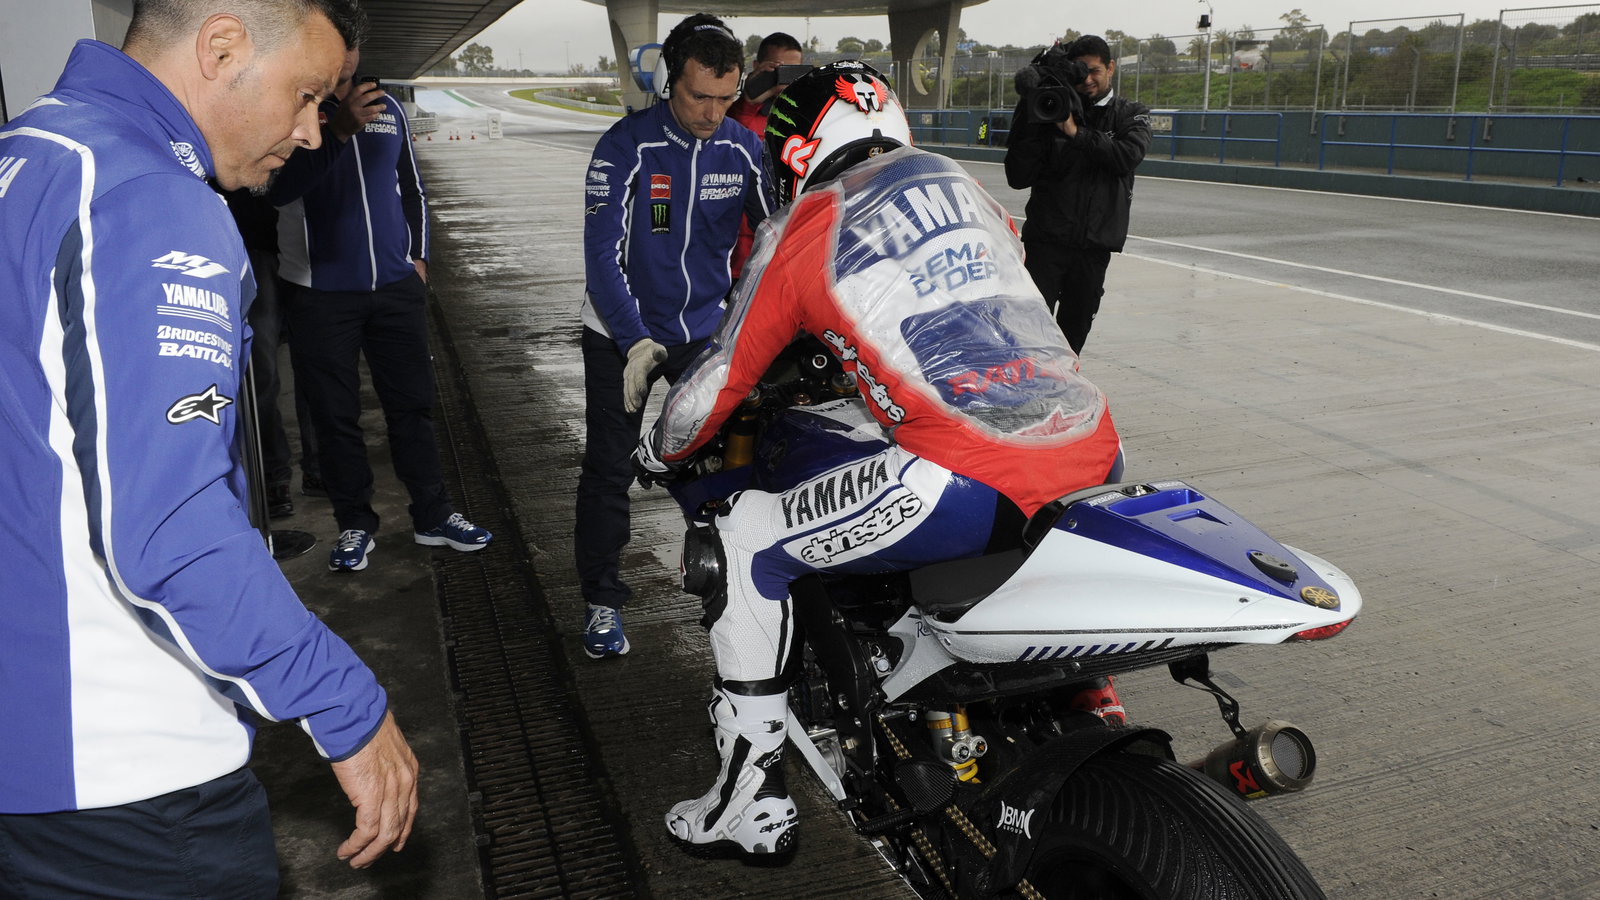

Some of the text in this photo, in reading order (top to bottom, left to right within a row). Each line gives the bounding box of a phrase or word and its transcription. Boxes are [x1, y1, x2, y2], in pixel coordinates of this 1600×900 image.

[709, 173, 743, 184] YAMAHA
[162, 283, 230, 320] YAMALUBE
[157, 325, 233, 356] BRIDGESTONE
[159, 342, 233, 370] BATTLAX
[781, 459, 889, 529] YAMAHA
[800, 493, 923, 563] alpinestars
